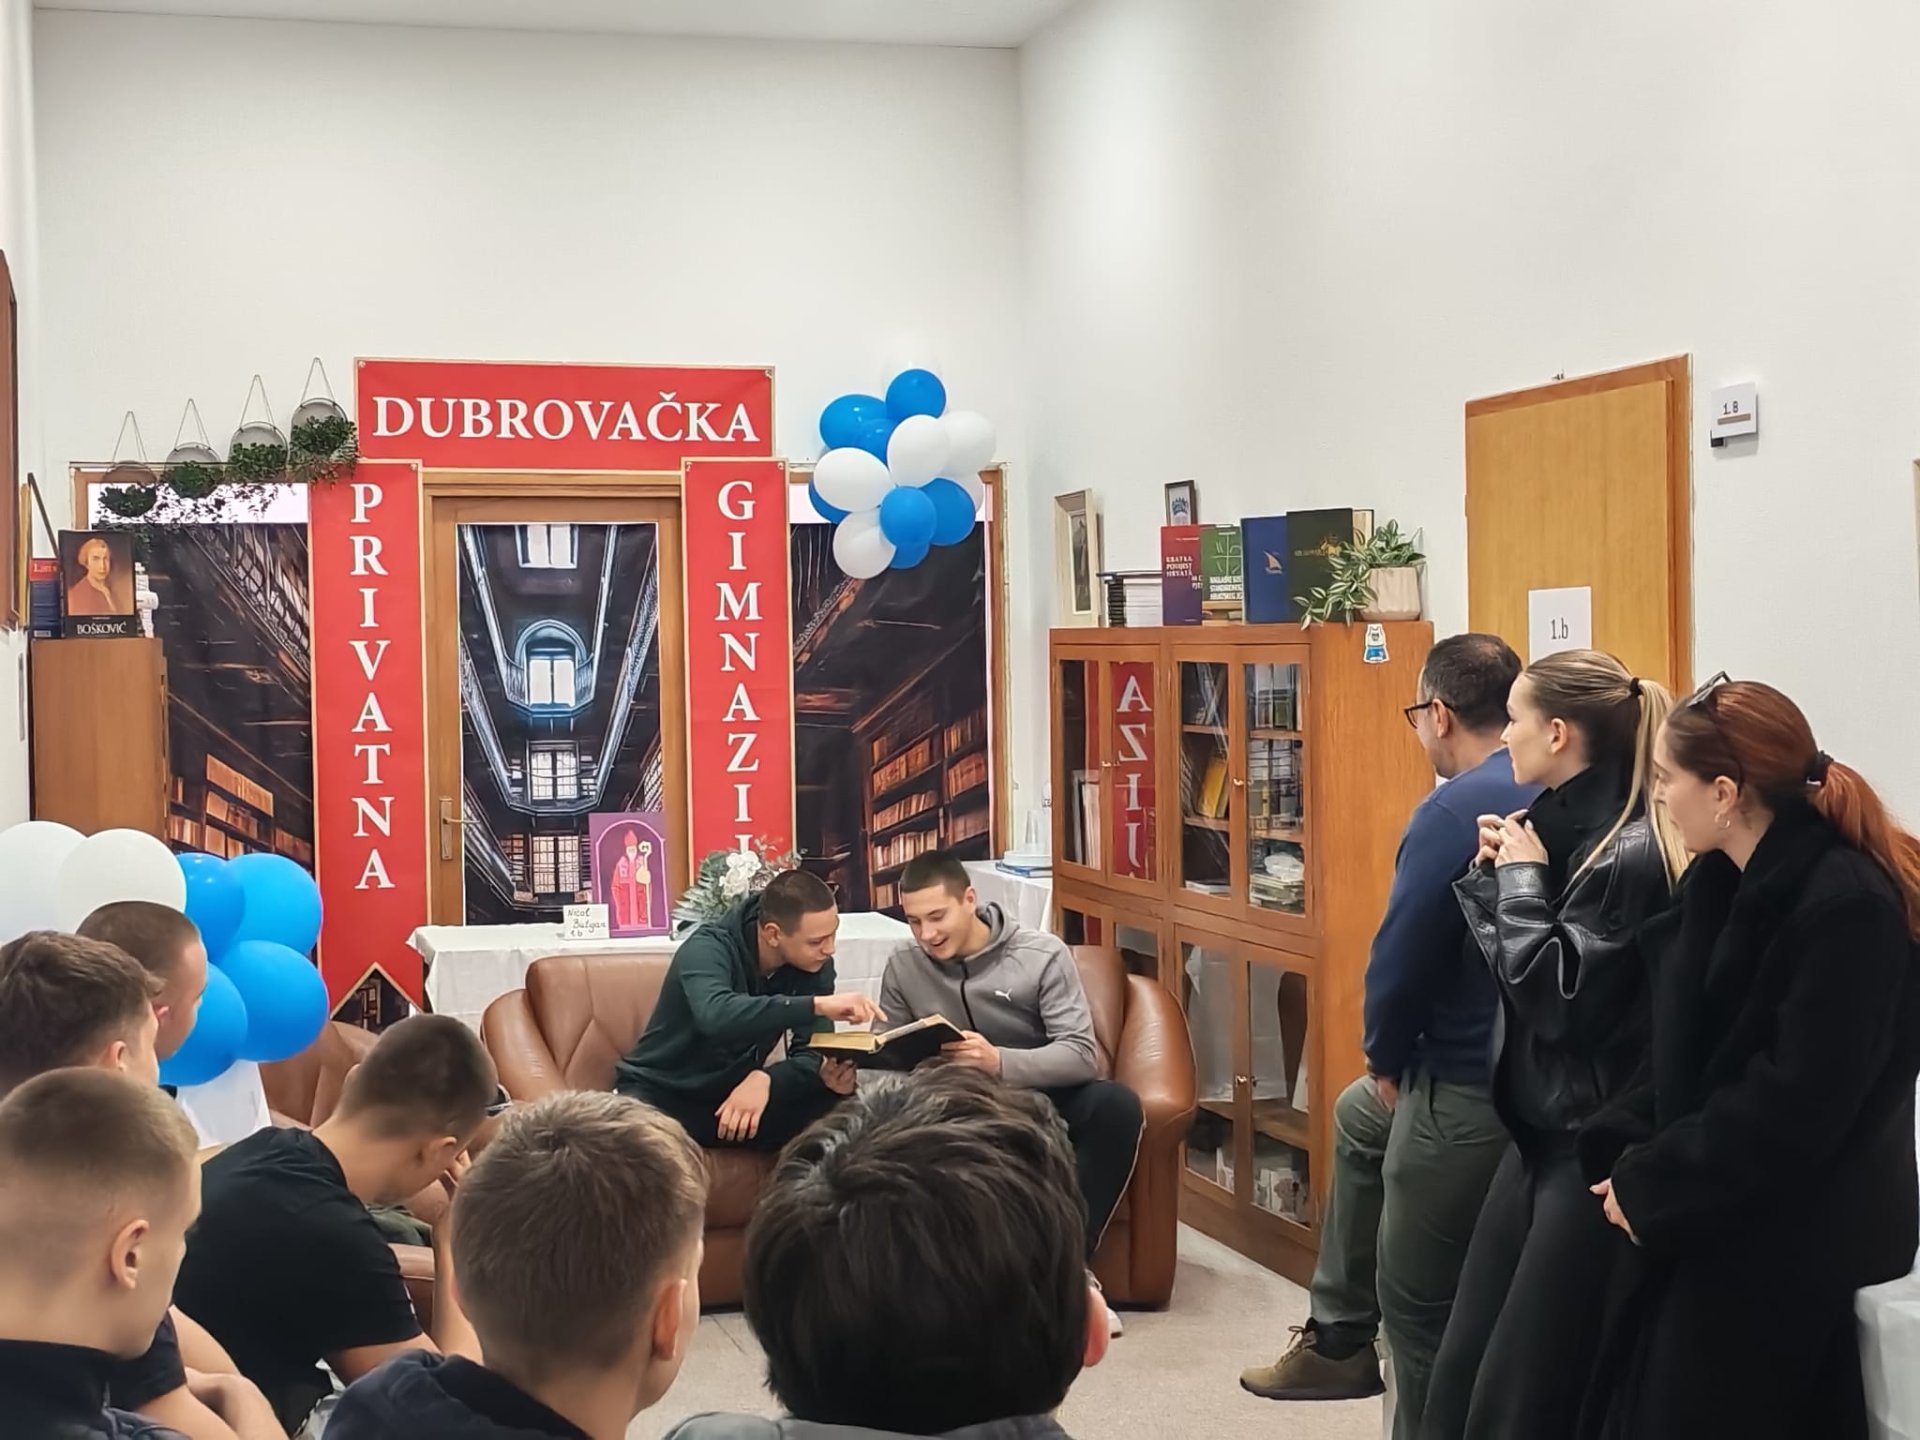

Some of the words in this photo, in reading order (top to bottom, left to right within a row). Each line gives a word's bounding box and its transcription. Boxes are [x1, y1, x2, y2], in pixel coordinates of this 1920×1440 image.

[371, 391, 761, 443] DUBROVAČKA
[76, 621, 128, 635] BOŠKOVIĆ
[1551, 617, 1569, 640] 1.b
[349, 483, 396, 890] PRIVATNA
